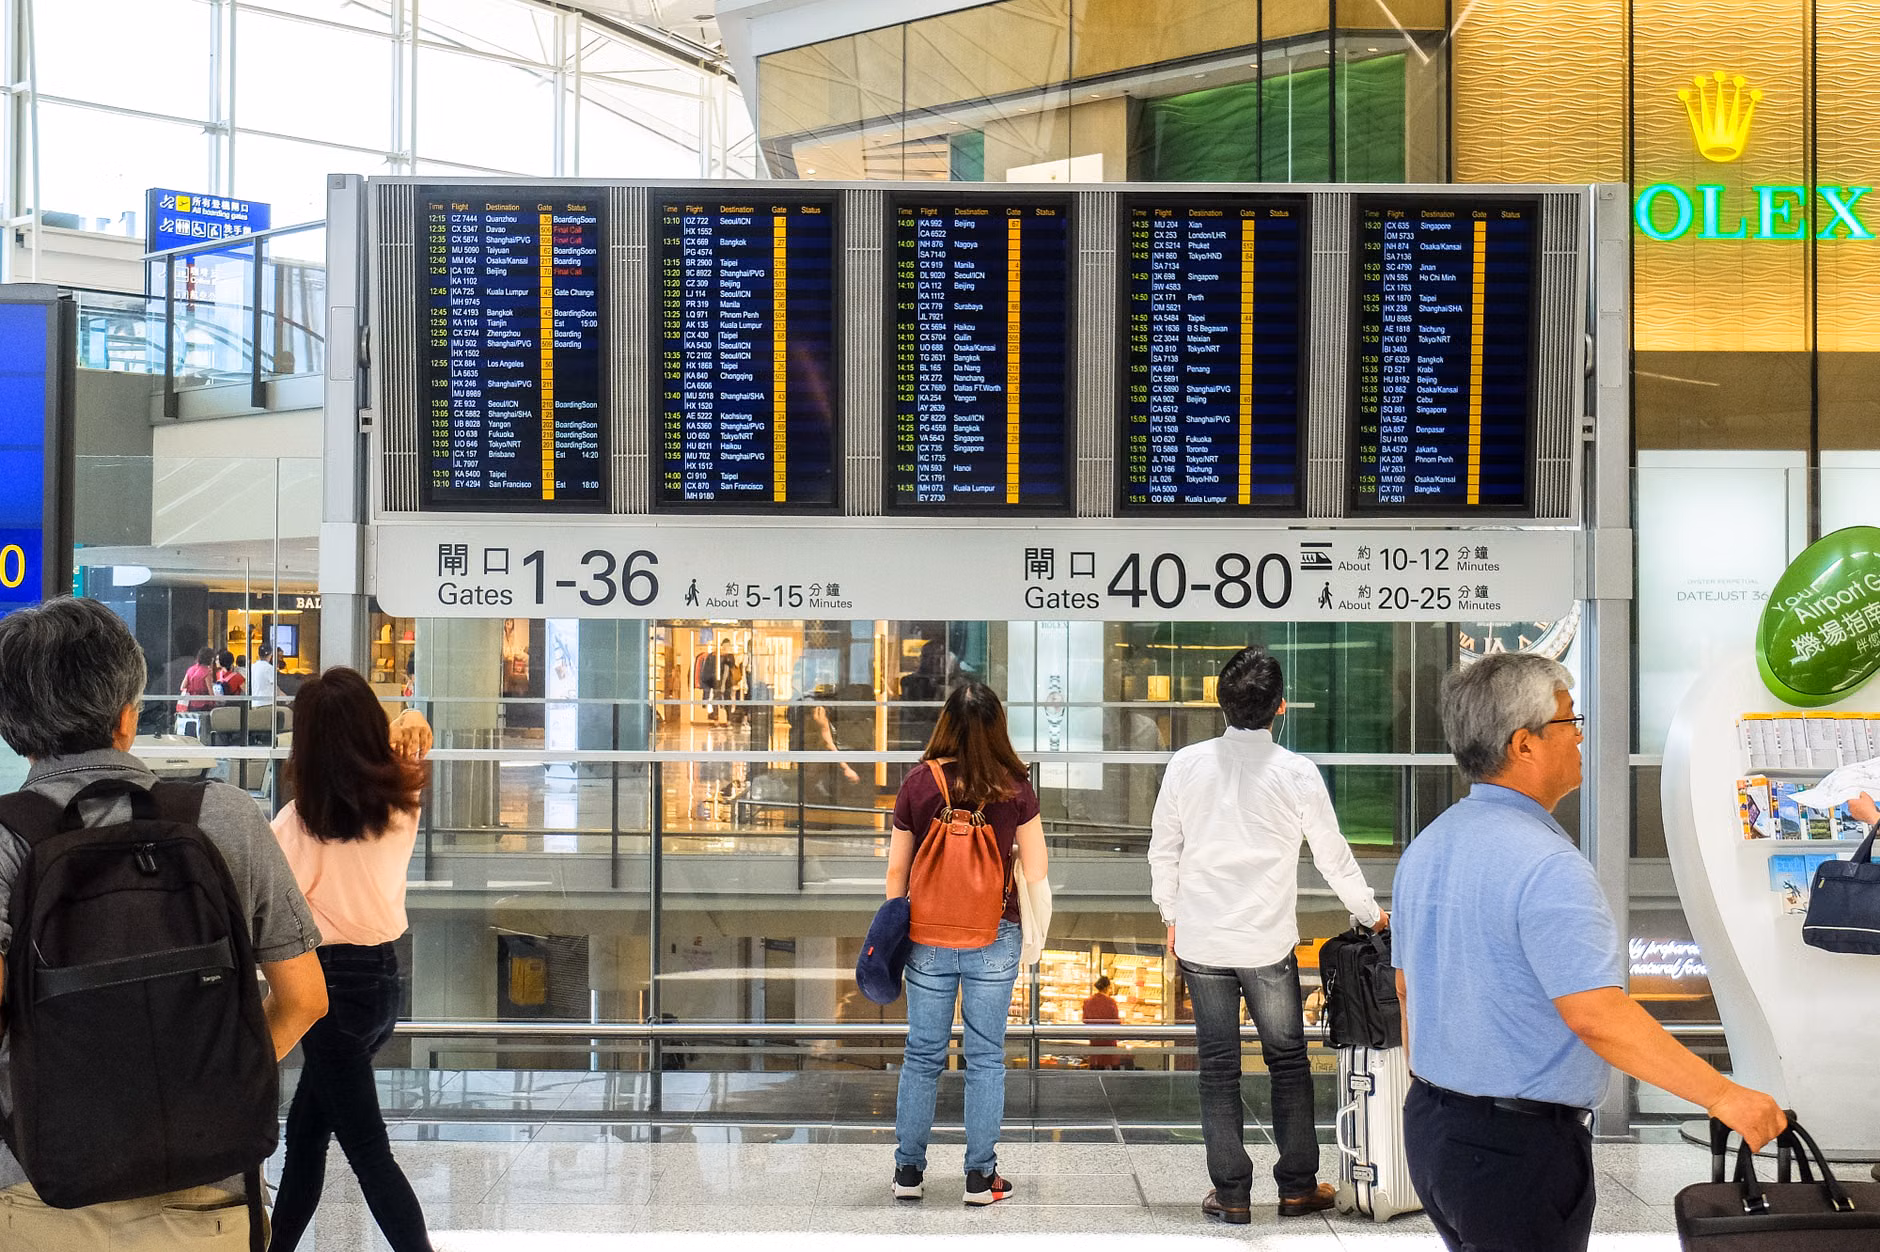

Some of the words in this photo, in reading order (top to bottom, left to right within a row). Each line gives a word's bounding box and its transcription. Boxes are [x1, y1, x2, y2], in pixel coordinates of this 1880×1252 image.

[452, 203, 468, 211] Flight
[686, 206, 703, 214] Flight
[801, 206, 821, 214] Status
[202, 208, 230, 220] boarding
[231, 212, 248, 221] gates
[920, 208, 938, 216] Flight
[1006, 208, 1021, 216] Gate
[554, 216, 596, 225] BoardingSoon
[954, 220, 975, 228] Beijing
[486, 237, 531, 245] Shanghai/PVG
[720, 238, 746, 247] Bangkok
[954, 241, 978, 249] Nagoya
[486, 257, 528, 265] Osaka/Kansai
[554, 258, 581, 266] Boarding
[487, 268, 507, 276] Beijing
[720, 269, 765, 278] Shanghai/PVG
[1188, 273, 1219, 281] Singapore
[720, 280, 740, 289] Beijing
[506, 289, 528, 297] Lumpur
[570, 289, 594, 298] Change
[954, 303, 983, 311] Surabaya
[1419, 305, 1462, 313] Shanghai/SHA
[743, 311, 759, 319] Penh
[954, 354, 980, 362] Bangkok
[1418, 356, 1444, 364] Bangkok
[500, 360, 524, 369] Angeles
[1187, 366, 1210, 374] Penang
[720, 373, 753, 381] Chongqing
[954, 375, 984, 383] Nanchang
[954, 395, 976, 403] Yangon
[1416, 426, 1445, 434] Denpasar
[720, 433, 753, 441] Tokyo/NRT
[954, 435, 984, 443] Singapore
[1186, 465, 1212, 473] Taichung
[1358, 546, 1370, 559] 約
[1458, 546, 1488, 559] 分鐘
[439, 544, 508, 576] 閘口
[1380, 548, 1449, 570] 10-12
[1025, 548, 1095, 580] 閘口
[1338, 562, 1370, 570] About
[1458, 562, 1499, 571] Minutes
[524, 550, 658, 606] 1-36
[1108, 553, 1292, 609] 40-80
[439, 583, 512, 605] Gates
[726, 583, 738, 596] 約
[809, 584, 840, 596] 分鐘
[1359, 585, 1371, 598] 約
[1458, 585, 1488, 598] 分鐘
[747, 585, 802, 607] 5-15
[1025, 587, 1099, 608] Gates
[1379, 587, 1451, 609] 20-25
[1677, 591, 1747, 601] DATEJUST
[1752, 591, 1769, 600] 36
[1794, 581, 1866, 624] Airport
[1864, 574, 1880, 591] G
[706, 598, 737, 607] About
[810, 599, 852, 608] Minutes
[1339, 601, 1370, 609] About
[1459, 601, 1500, 609] Minutes
[1642, 941, 1700, 959] prepare
